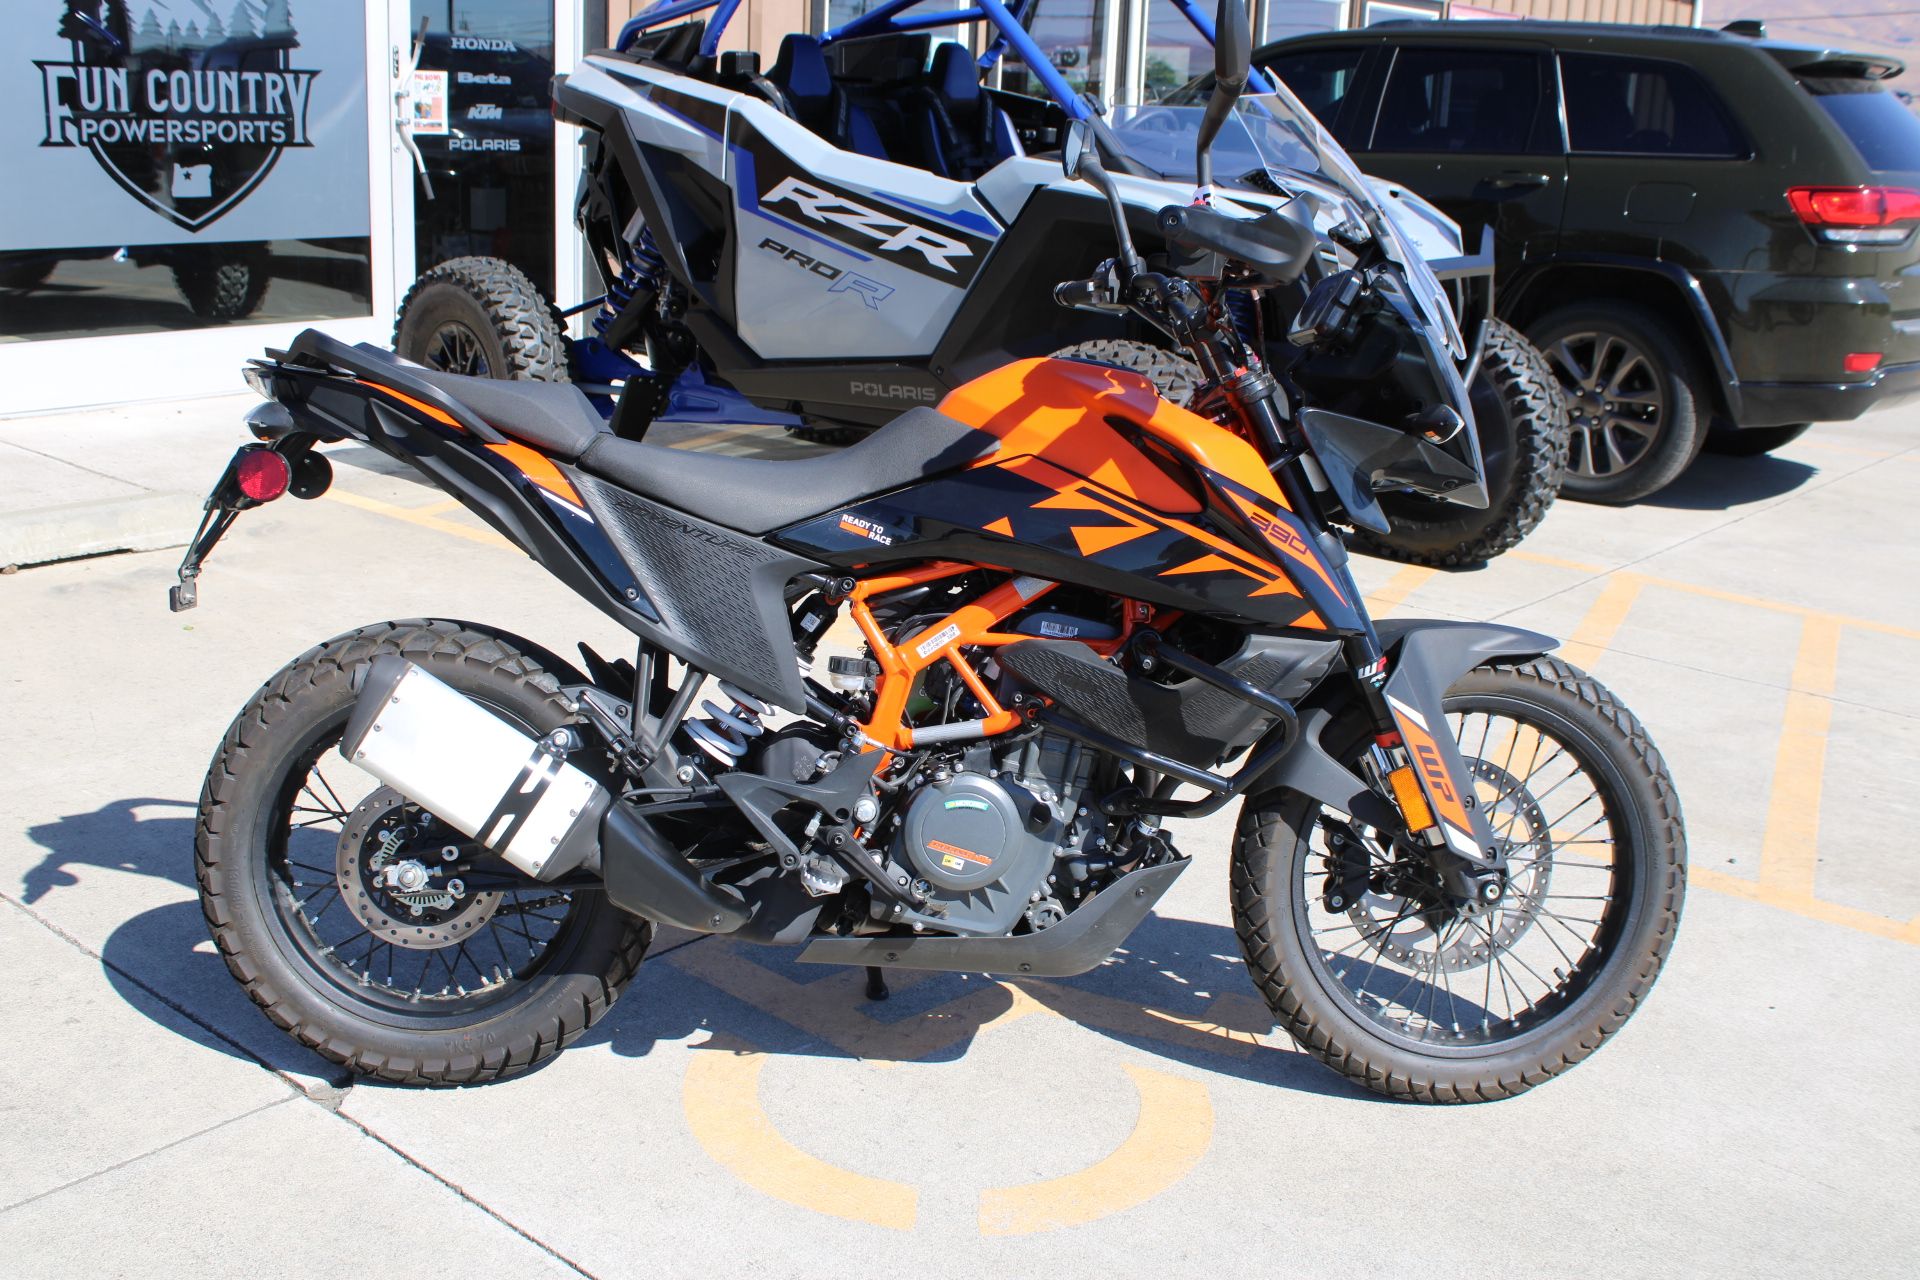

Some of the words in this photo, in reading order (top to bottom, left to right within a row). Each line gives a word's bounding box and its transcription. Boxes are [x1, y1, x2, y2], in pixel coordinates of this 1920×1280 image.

[451, 37, 517, 52] HONDA
[457, 71, 511, 84] Beta
[43, 64, 131, 143] FUN
[146, 68, 312, 144] COUNTRY
[467, 104, 503, 119] KTM
[80, 118, 287, 143] POWERSPORTS
[449, 138, 521, 151] POLARIS
[761, 175, 974, 273] RZR
[758, 237, 843, 281] PRO
[827, 270, 896, 311] R
[850, 381, 937, 401] POLARIS
[841, 513, 872, 530] READY
[872, 523, 884, 534] TO
[1249, 511, 1309, 556] 390
[868, 531, 893, 546] RACE
[1357, 656, 1388, 680] WP
[1415, 744, 1455, 803] WP
